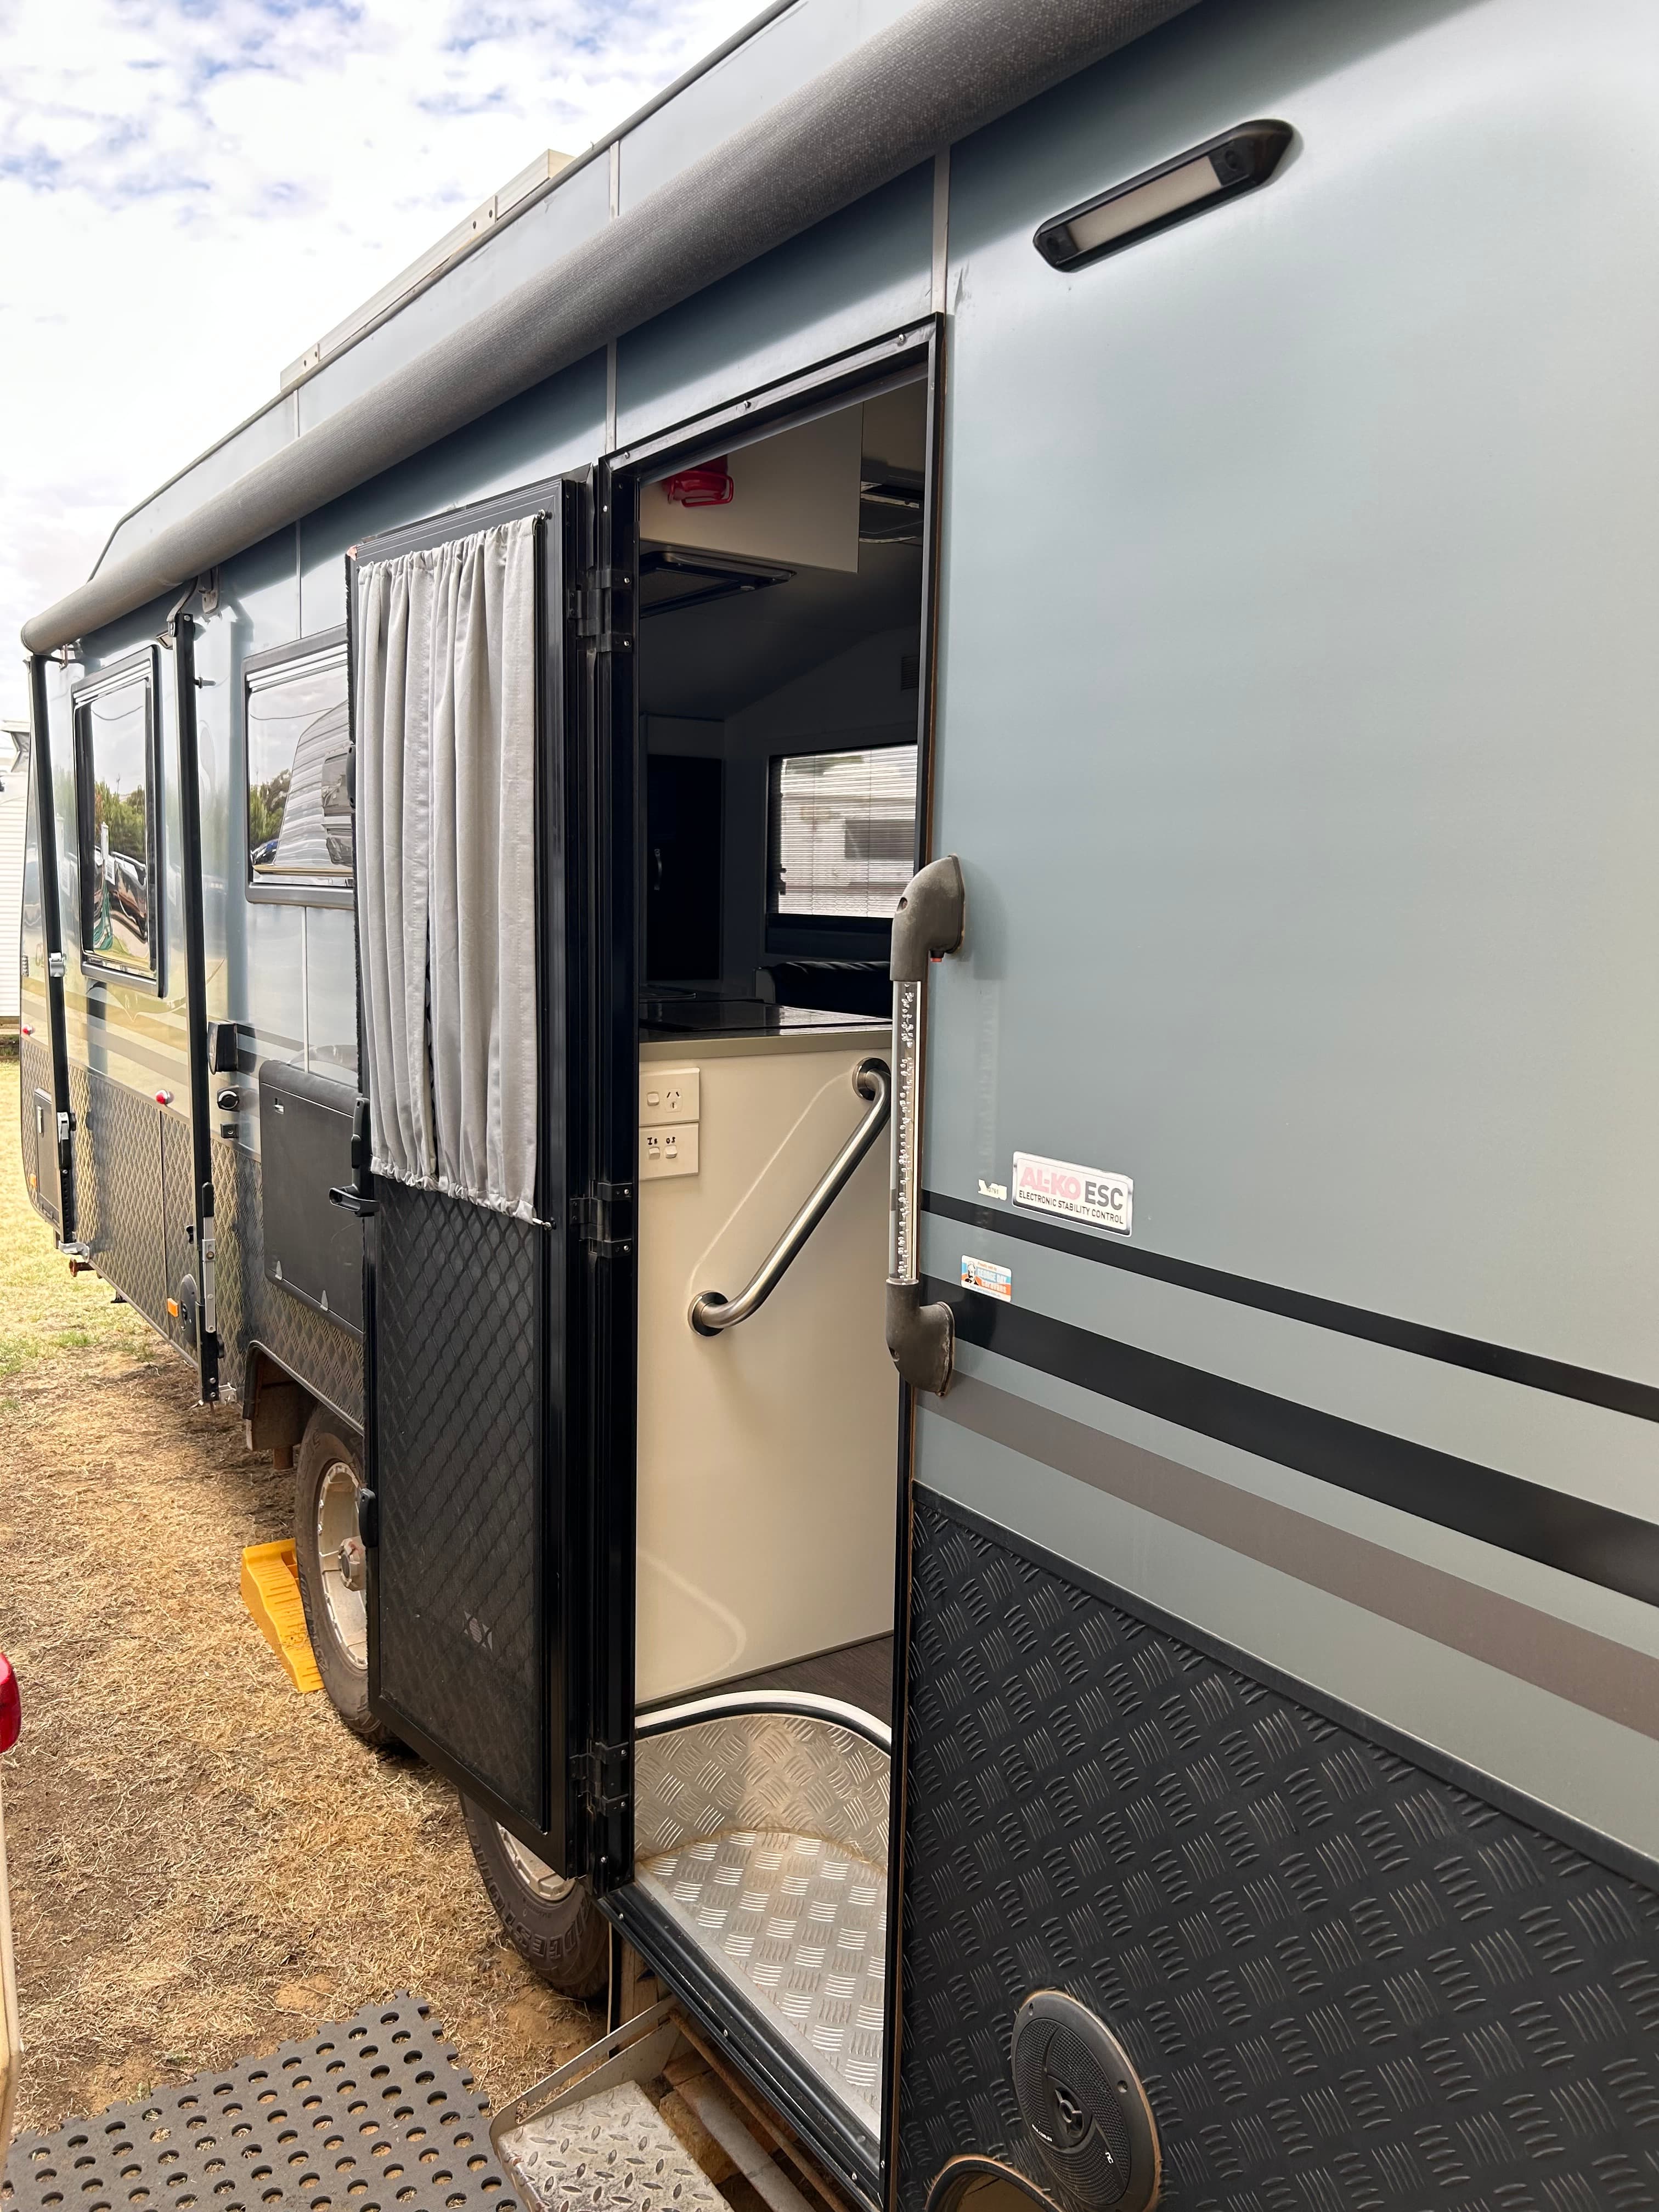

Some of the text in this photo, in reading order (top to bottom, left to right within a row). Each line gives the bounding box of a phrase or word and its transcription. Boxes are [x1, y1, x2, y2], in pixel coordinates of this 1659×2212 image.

[1019, 1190, 1124, 1224] ELECTRONIC STABILITY CONTROL
[1085, 1181, 1124, 1210] ESC
